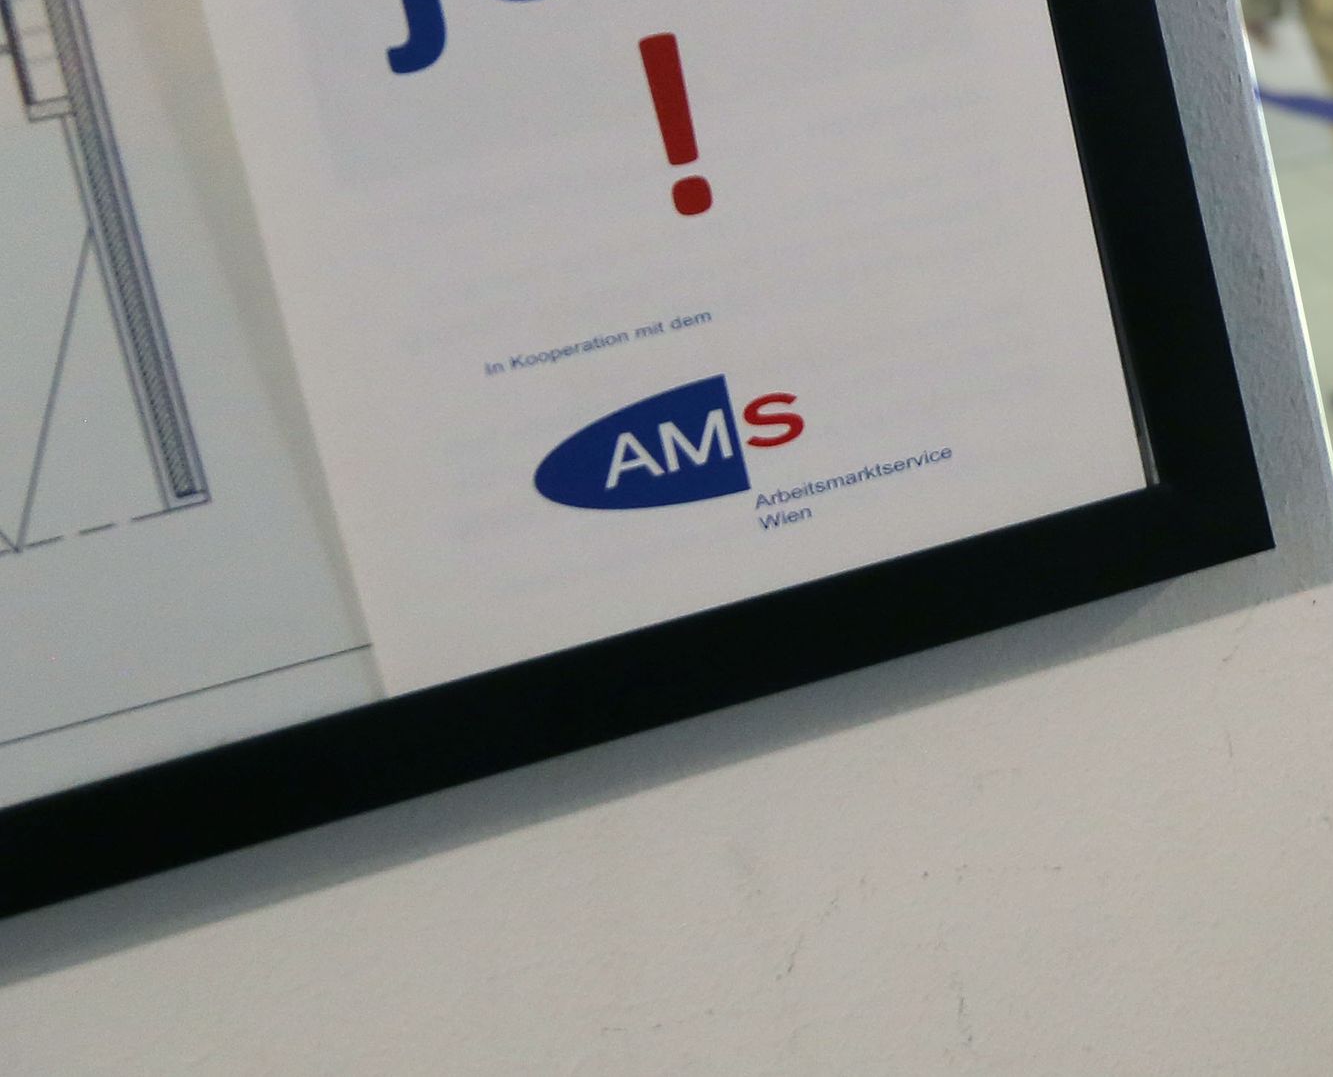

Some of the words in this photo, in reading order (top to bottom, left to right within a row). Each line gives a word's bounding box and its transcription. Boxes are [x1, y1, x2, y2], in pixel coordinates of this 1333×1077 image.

[639, 33, 712, 216] !
[484, 362, 504, 376] In
[510, 330, 629, 370] Kooperation
[635, 321, 665, 339] mit
[670, 311, 712, 330] dem
[605, 392, 805, 490] AMS
[755, 447, 952, 510] Arbeitsmarktservice
[759, 507, 813, 530] Wien
